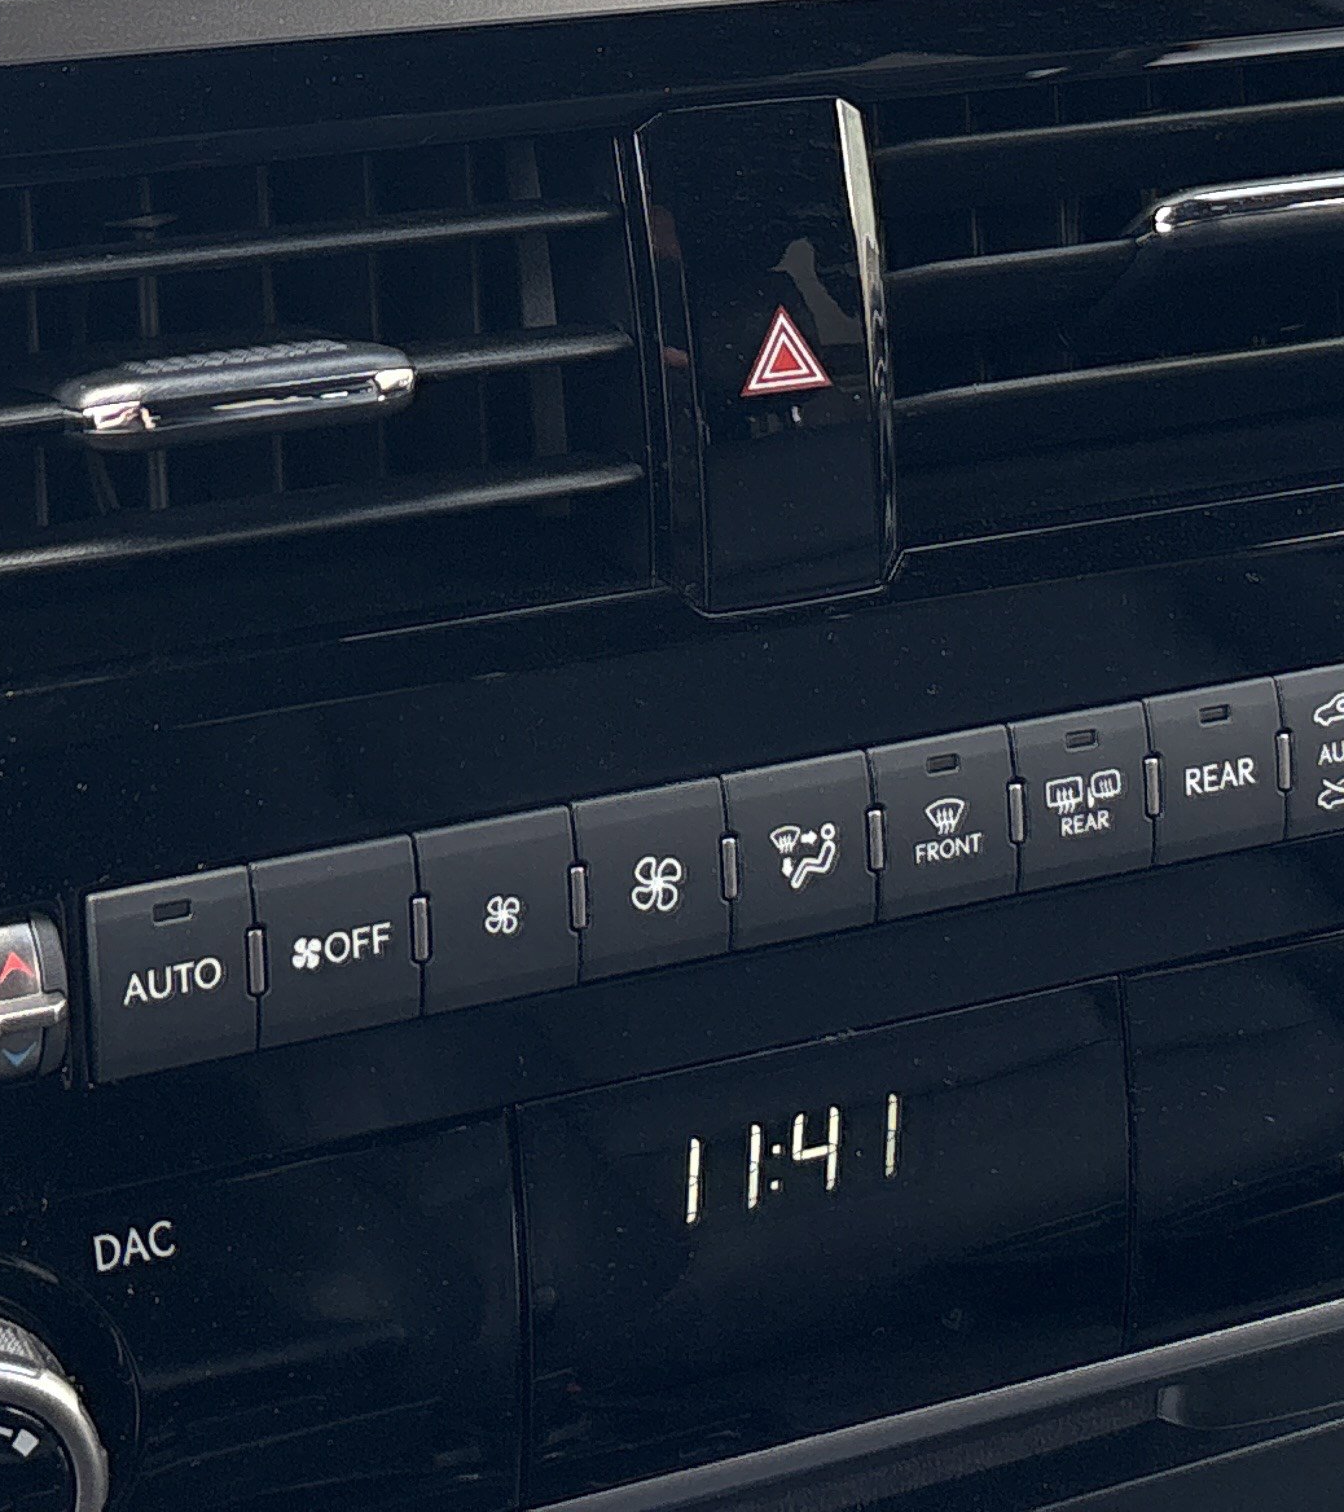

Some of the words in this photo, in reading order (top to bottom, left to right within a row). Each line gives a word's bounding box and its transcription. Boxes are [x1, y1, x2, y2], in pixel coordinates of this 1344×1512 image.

[1184, 757, 1256, 796] REAR
[1060, 810, 1110, 836] REAR
[915, 833, 982, 863] FRONT
[324, 922, 392, 964] OFF
[123, 957, 222, 1005] AUTO
[685, 1092, 898, 1224] 11:41
[93, 1220, 176, 1272] DAC
